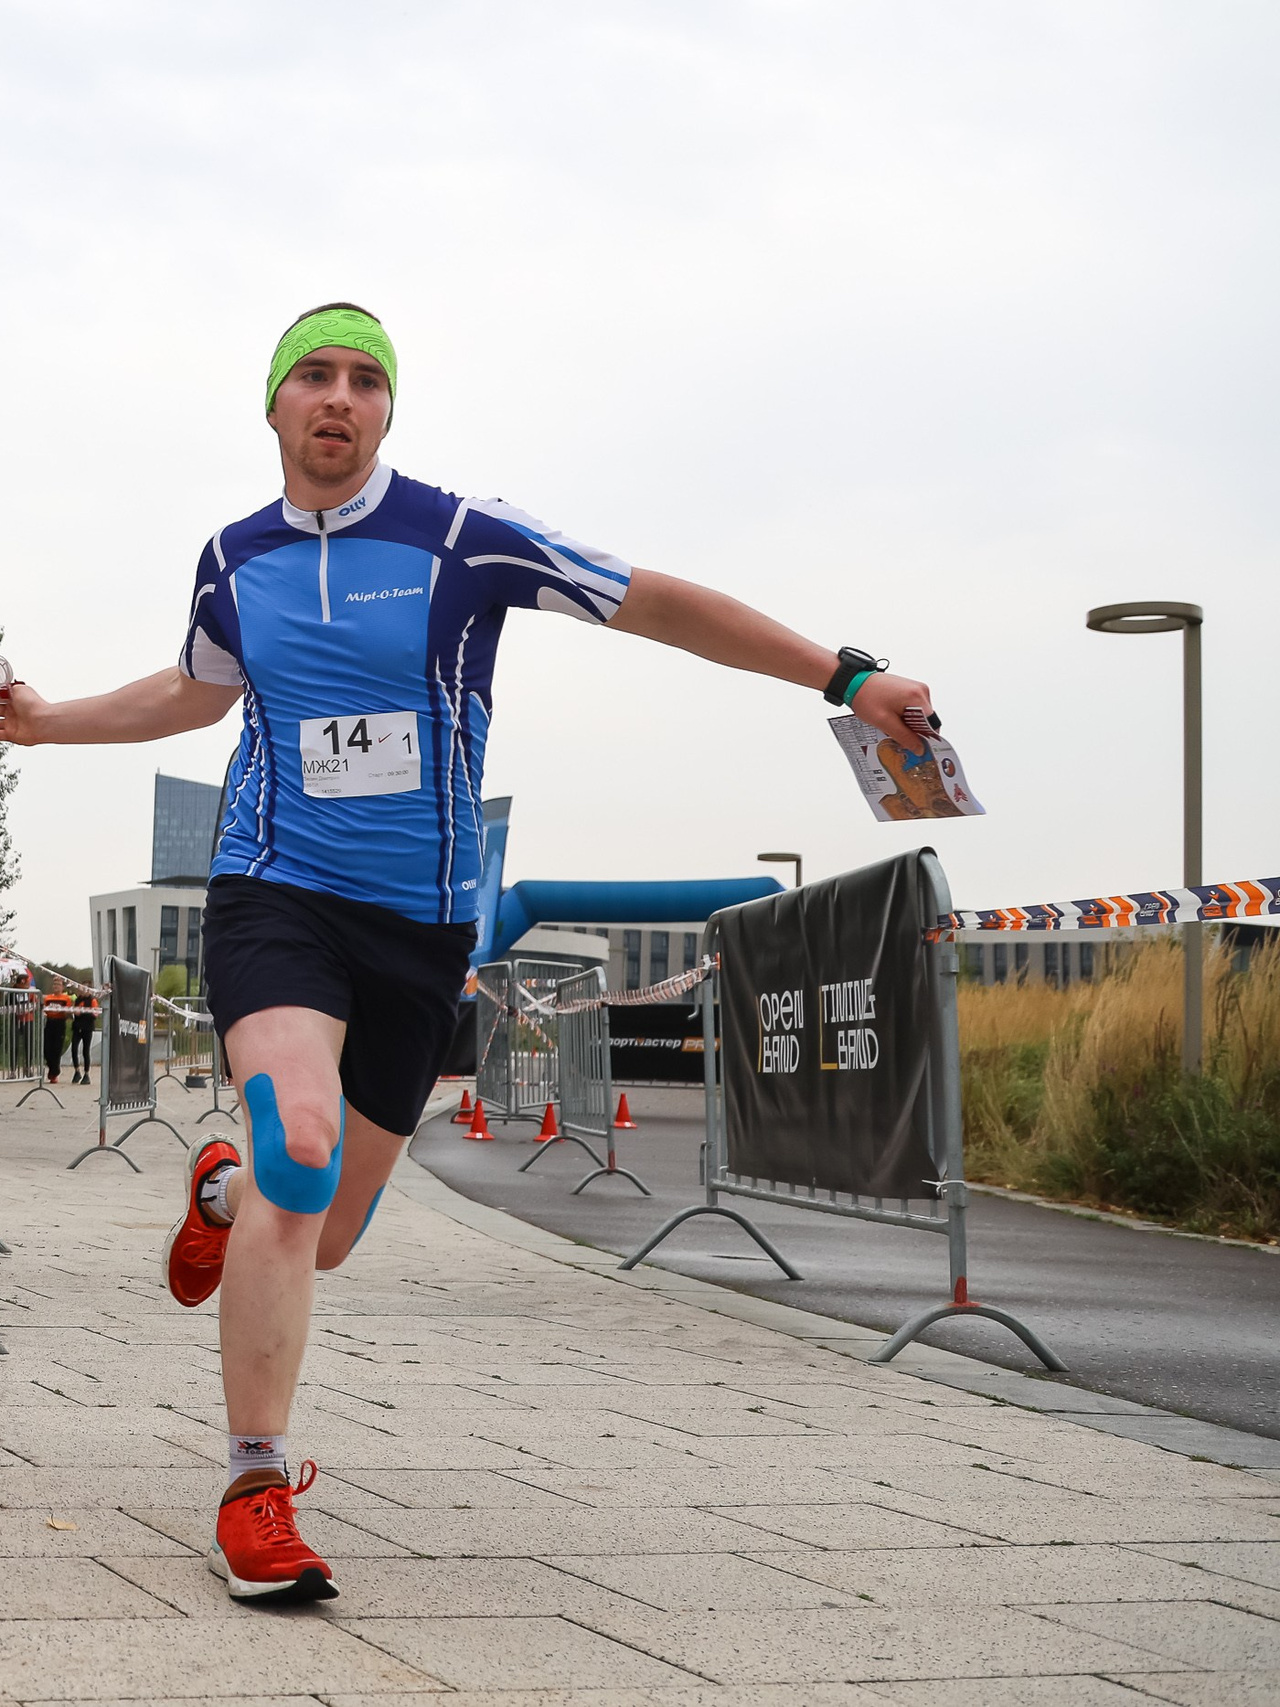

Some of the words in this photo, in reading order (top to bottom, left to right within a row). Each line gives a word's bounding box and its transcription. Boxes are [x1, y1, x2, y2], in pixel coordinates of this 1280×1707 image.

[338, 497, 366, 516] OLLY
[345, 587, 424, 602] Mipt-O-Team
[323, 718, 372, 755] 14
[402, 732, 412, 754] 1
[303, 759, 349, 774] МЖ21
[821, 978, 876, 1024] TIMING
[762, 1034, 800, 1073] BAND
[837, 1028, 879, 1070] BAND
